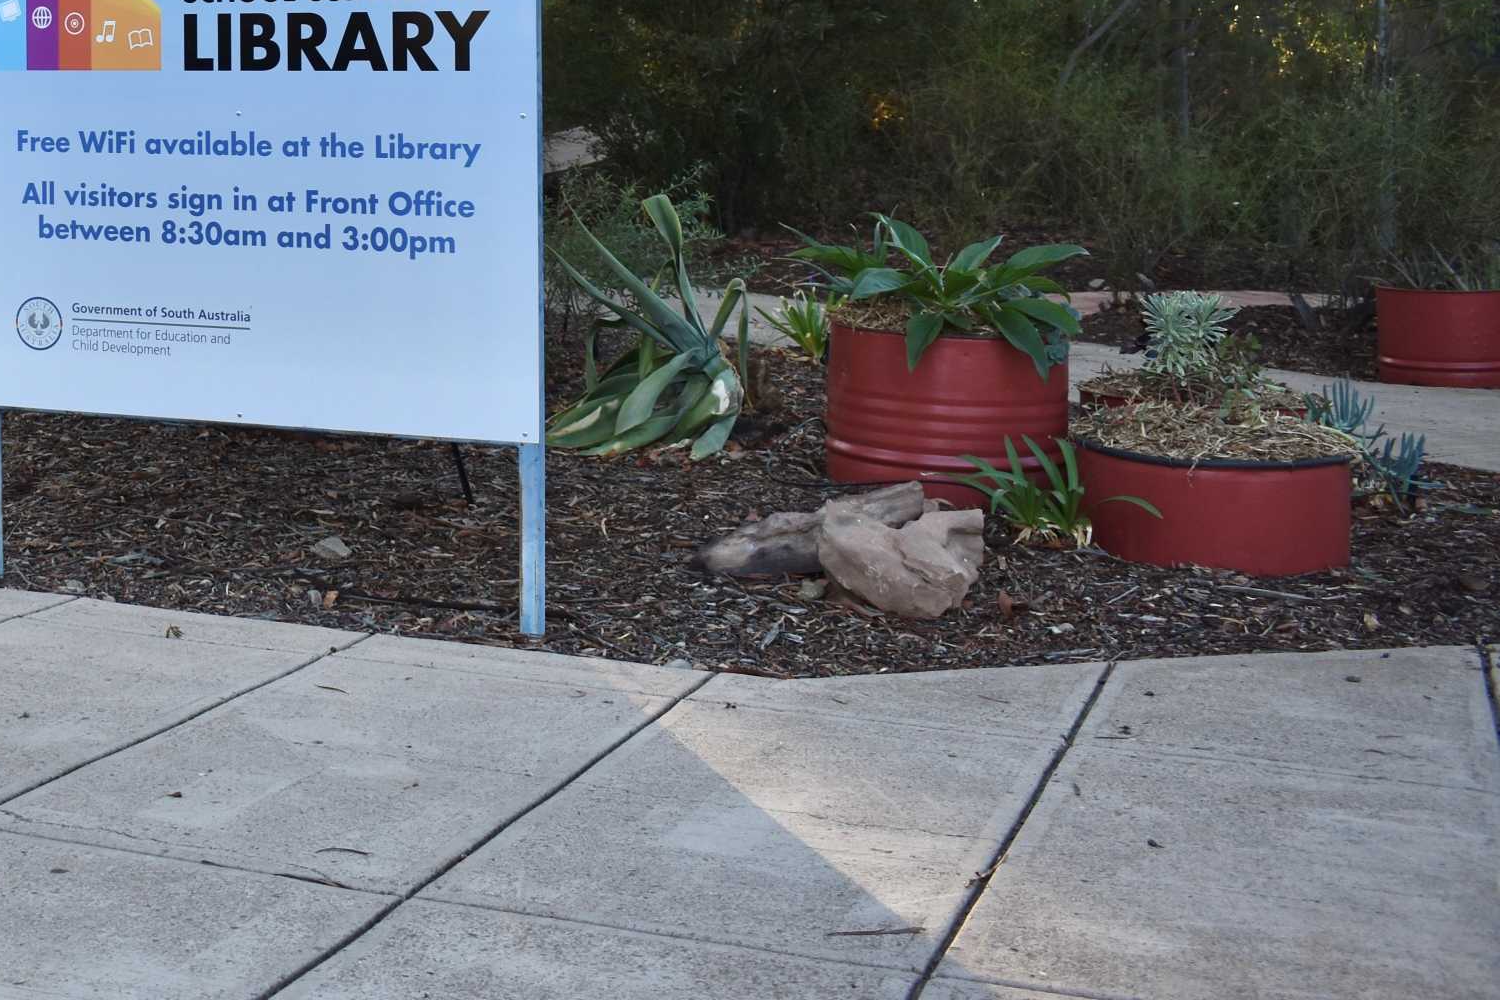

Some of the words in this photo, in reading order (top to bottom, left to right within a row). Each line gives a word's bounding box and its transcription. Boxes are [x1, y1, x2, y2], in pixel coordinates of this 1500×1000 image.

[183, 10, 491, 72] LIBRARY
[16, 130, 70, 154] Free
[79, 131, 135, 155] WiFi
[145, 131, 272, 158] available
[282, 134, 310, 158] at
[320, 133, 364, 159] the
[375, 134, 481, 167] Library
[22, 182, 55, 205] All
[65, 184, 158, 209] visitors
[168, 185, 222, 216] sign
[233, 187, 257, 212] in
[268, 189, 296, 214] at
[305, 189, 378, 215] Front
[388, 191, 475, 218] Office
[38, 215, 151, 243] between
[161, 220, 267, 247] 8:30am
[277, 223, 331, 249] and
[342, 226, 455, 259] 3:00pm
[72, 303, 142, 317] Government
[146, 307, 157, 318] of
[161, 307, 194, 319] South
[198, 310, 251, 322] Australia
[72, 325, 132, 340] Department
[136, 327, 151, 340] for
[155, 329, 207, 343] Education
[211, 332, 230, 345] and
[72, 340, 98, 351] Child
[102, 340, 171, 357] Development
